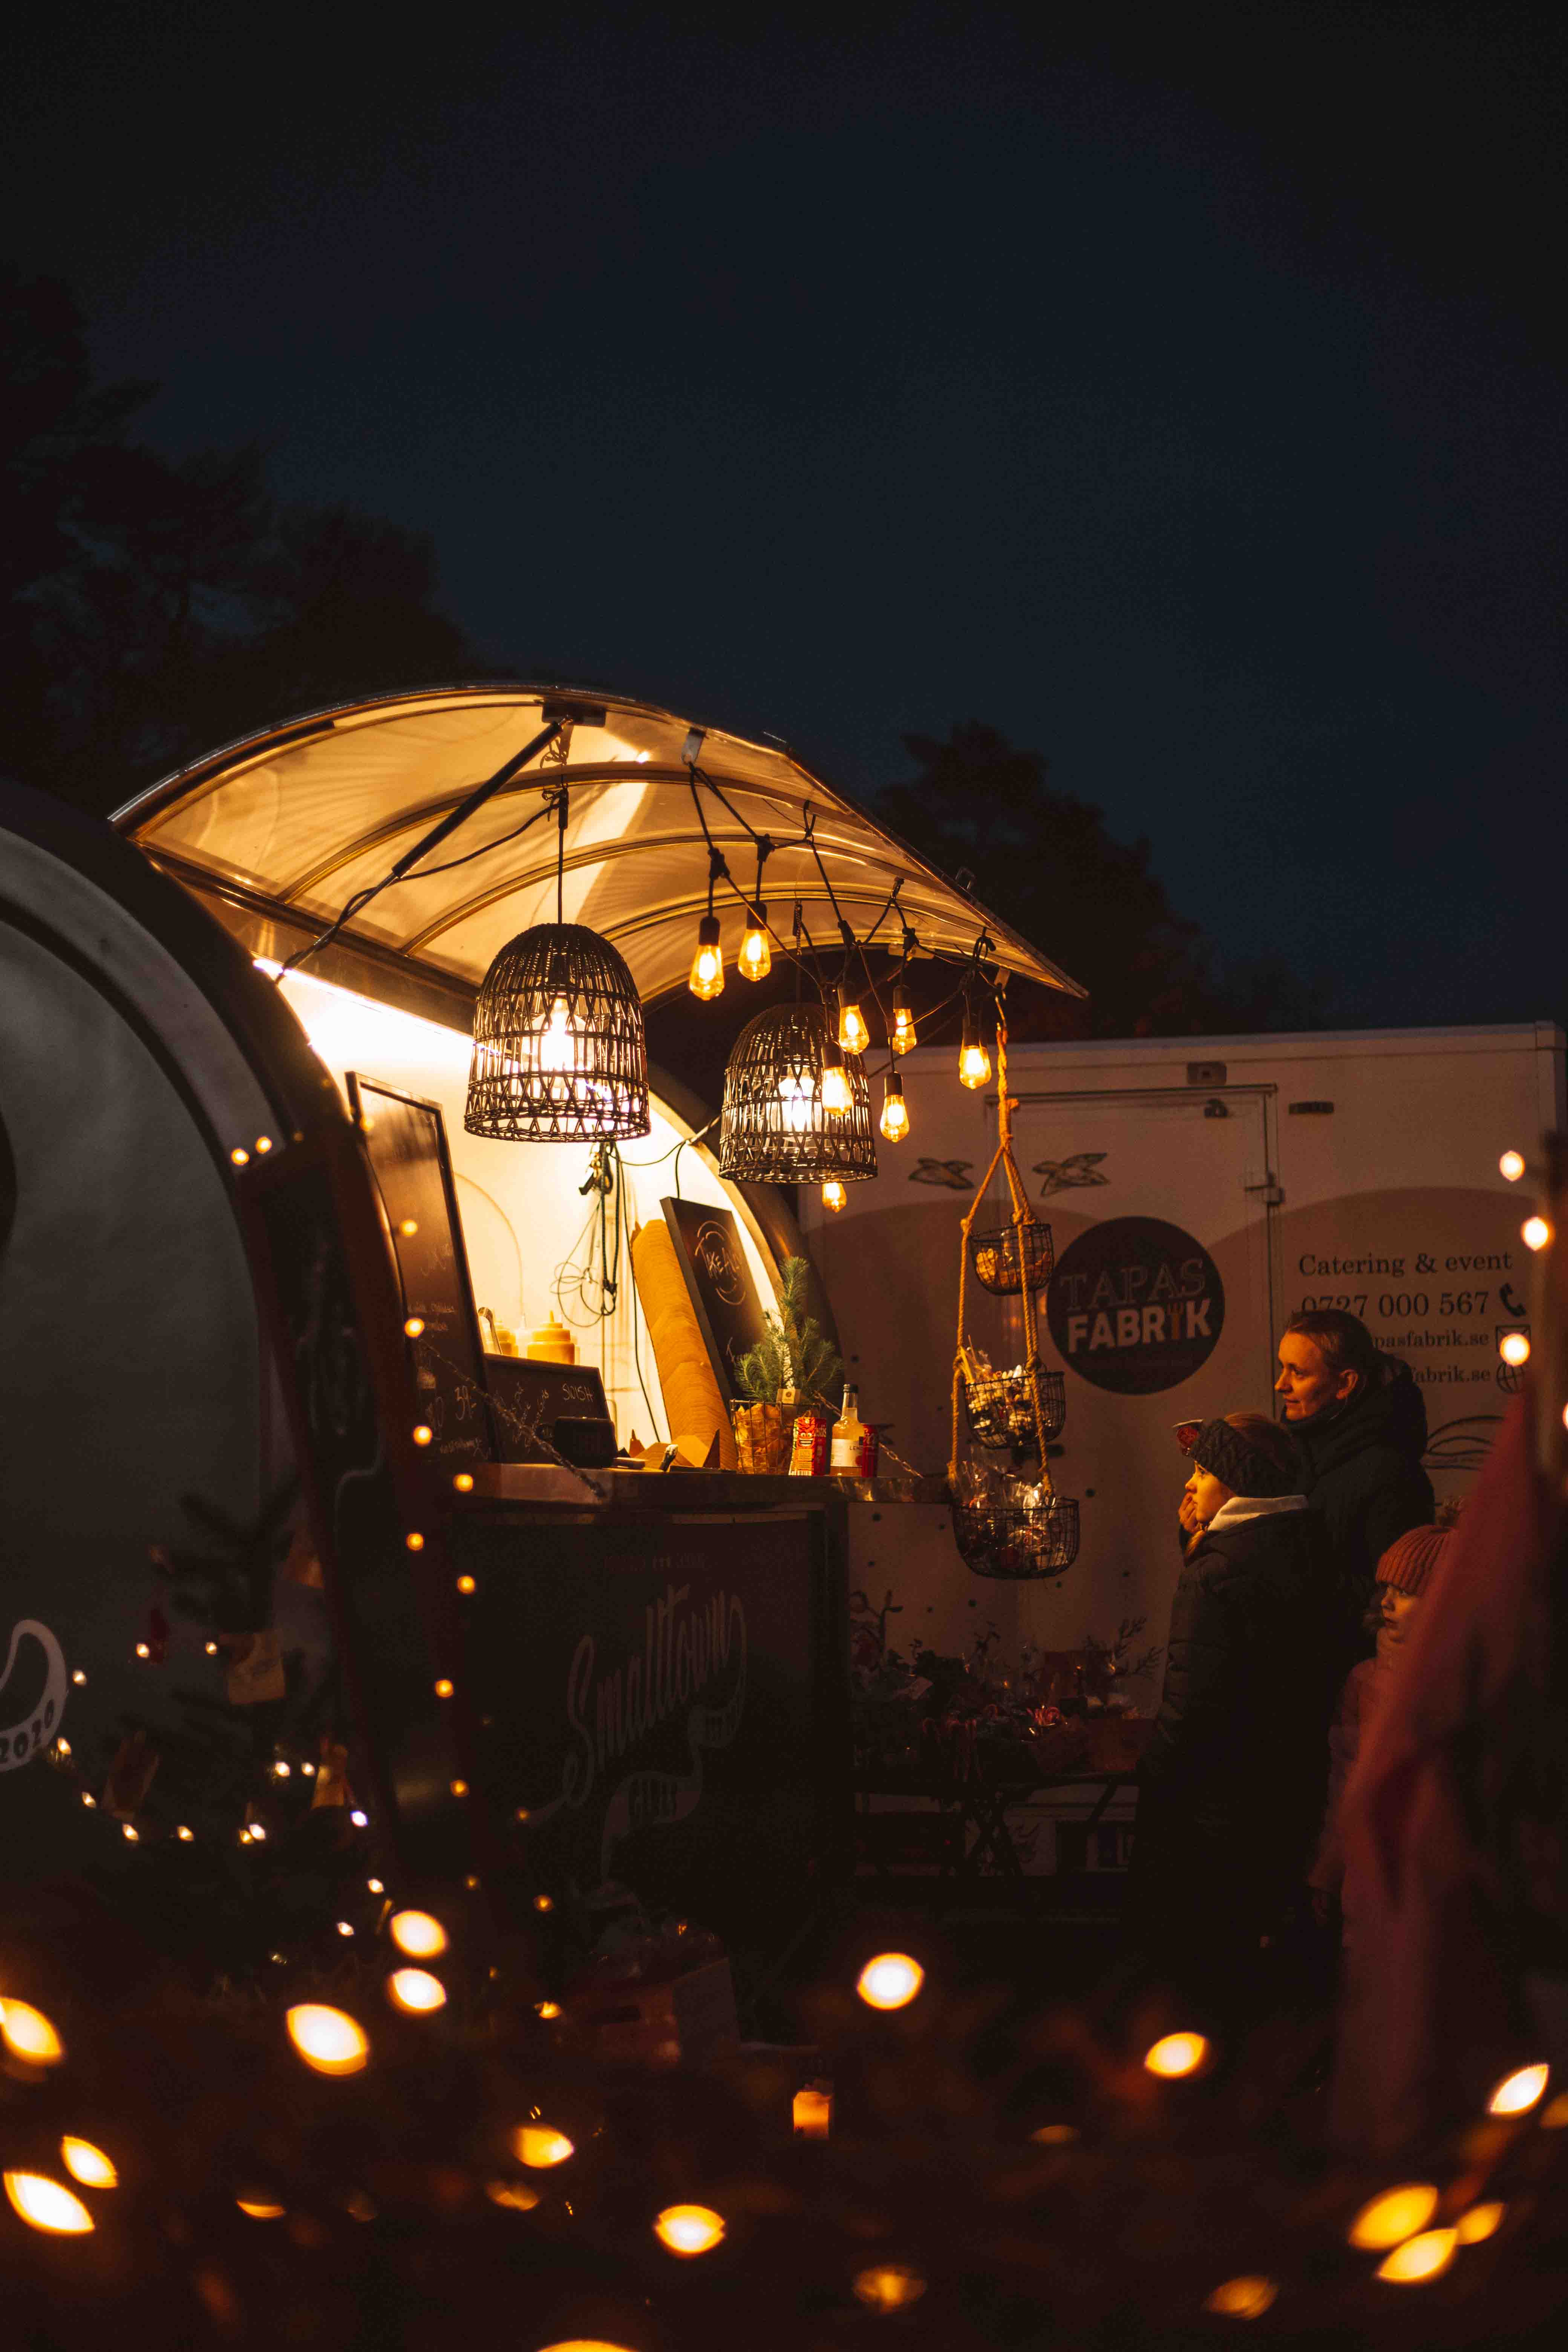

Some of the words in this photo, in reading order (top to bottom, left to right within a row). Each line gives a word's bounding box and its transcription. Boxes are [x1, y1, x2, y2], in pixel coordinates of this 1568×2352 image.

[1299, 1253, 1406, 1277] Catering
[1415, 1253, 1438, 1274] &
[1445, 1252, 1513, 1272] event
[1059, 1257, 1206, 1311] TAPAS
[1379, 1293, 1429, 1317] 000
[1439, 1291, 1489, 1316] 567
[1067, 1298, 1212, 1353] FABRIK
[1372, 1328, 1490, 1350] pasfabrik.se
